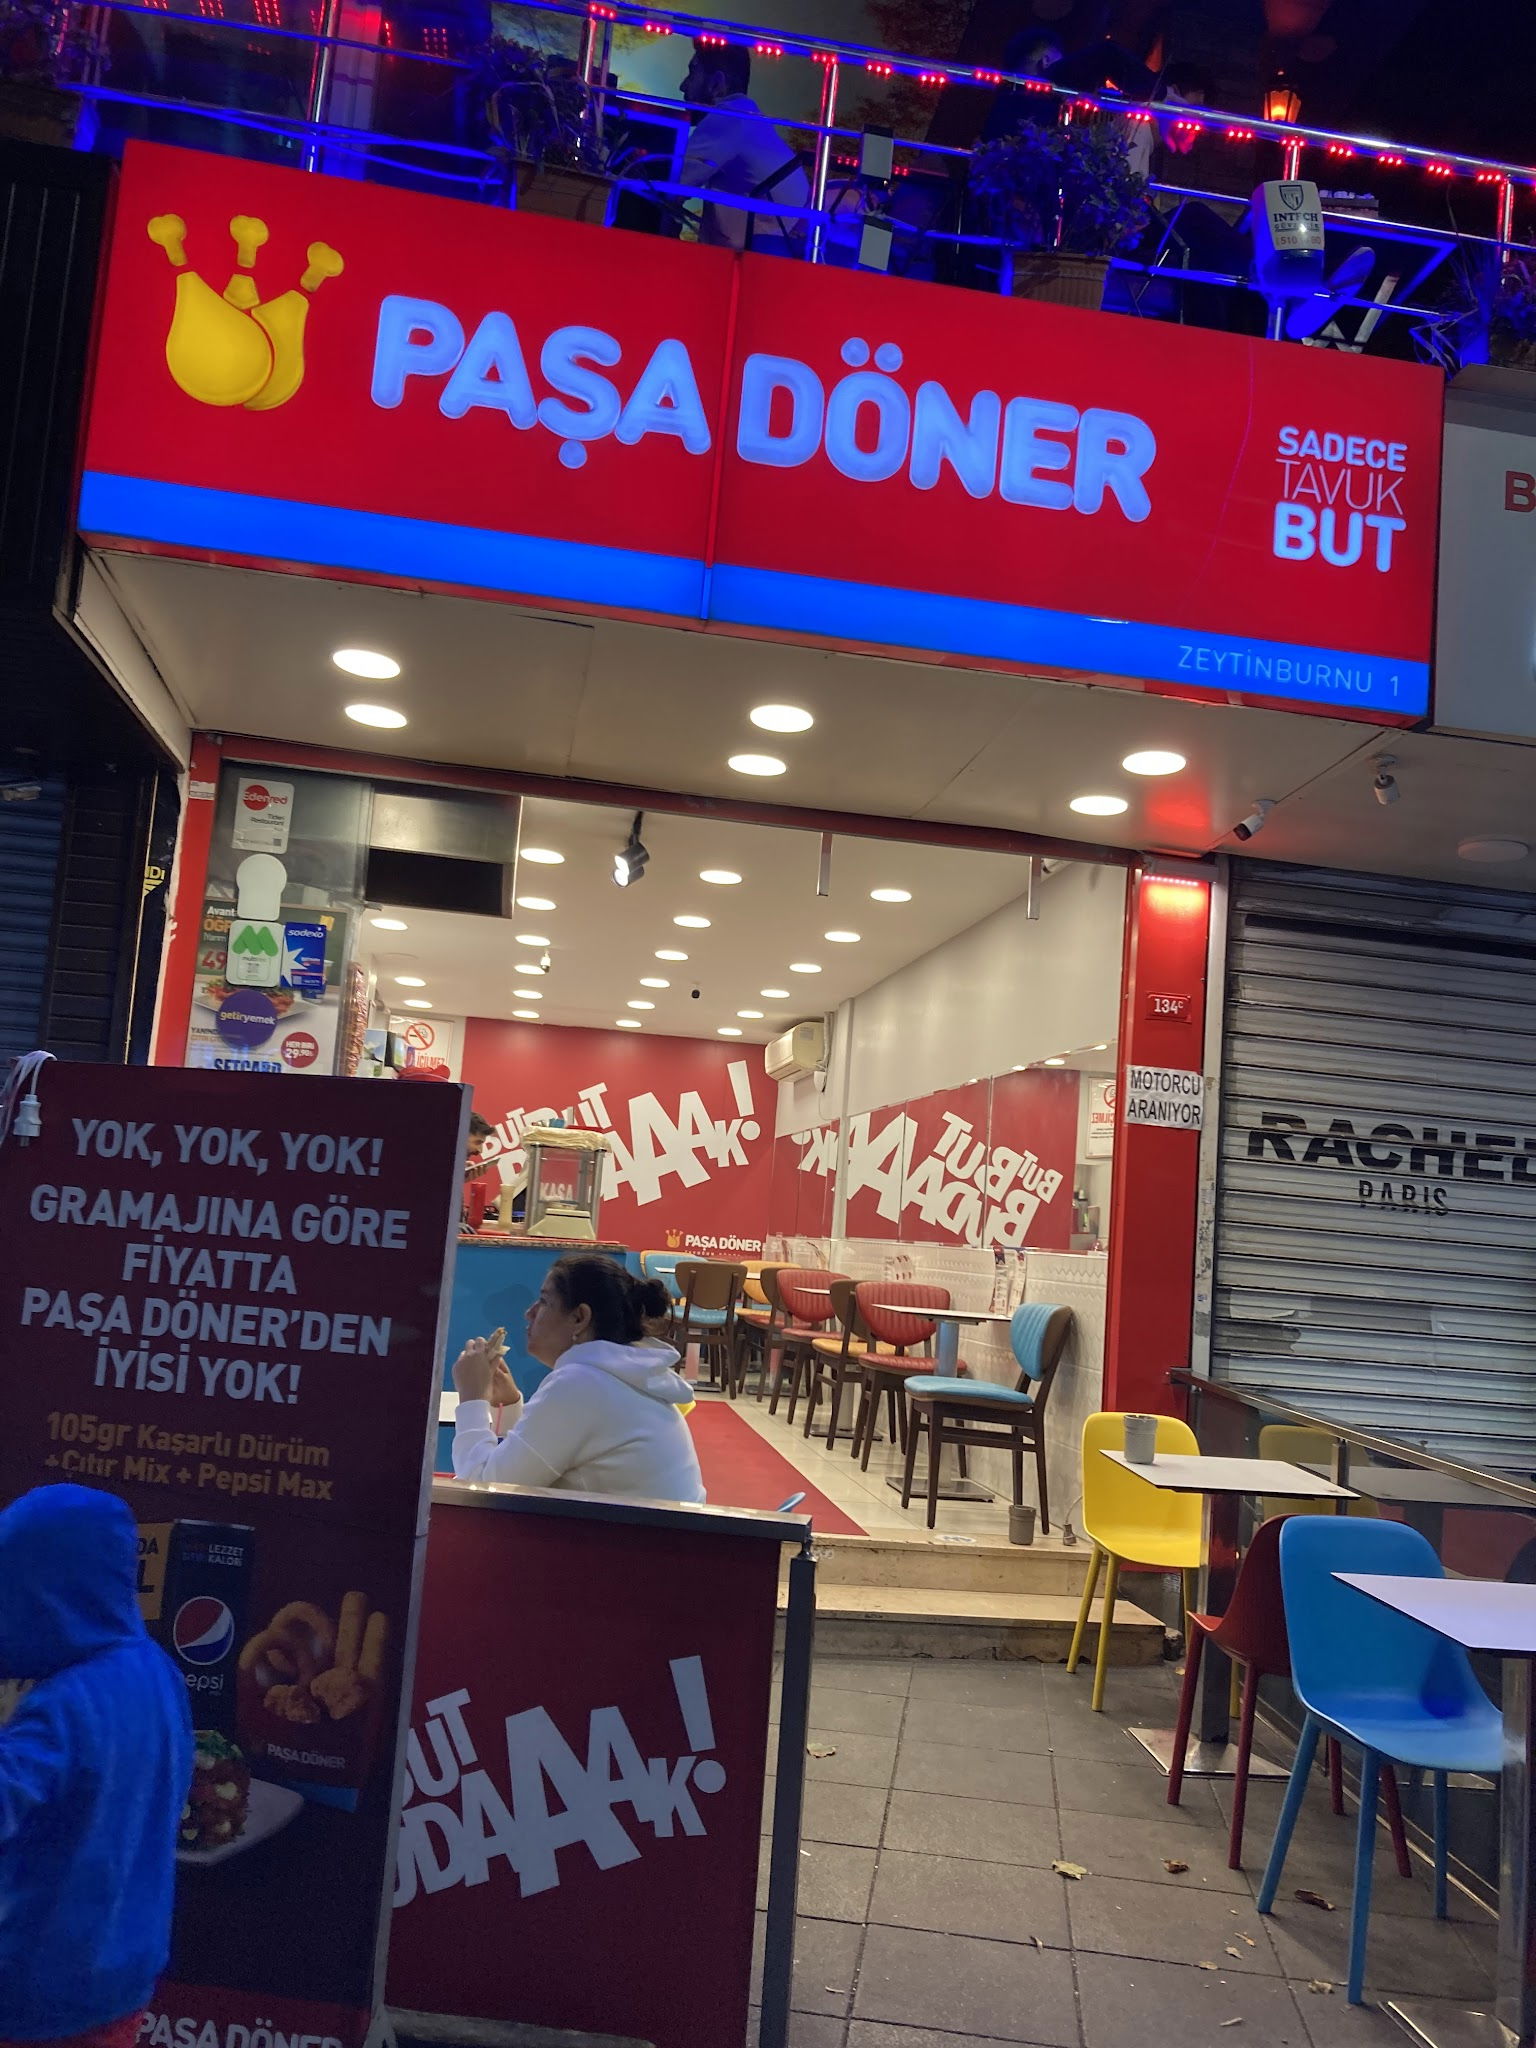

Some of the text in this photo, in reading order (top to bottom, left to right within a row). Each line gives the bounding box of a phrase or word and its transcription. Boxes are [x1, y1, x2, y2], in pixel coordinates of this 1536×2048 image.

[371, 294, 1158, 524] PAŞA DÖNER
[1277, 425, 1408, 473] SADECE
[1275, 458, 1404, 516] TAVUK
[1272, 500, 1408, 573] BUT
[1178, 644, 1399, 697] ZEYTİNBURNU 1
[243, 790, 288, 805] Edenred
[287, 928, 324, 938] sodexo
[220, 1010, 276, 1025] getiryemek
[1130, 1069, 1201, 1096] MOTORCU
[1126, 1098, 1201, 1125] ARANIYOR
[72, 1118, 384, 1177] YOK, YOK, YOK!
[29, 1183, 411, 1250] GRAMAJINA GÖRE
[1358, 1179, 1449, 1217] PARIS
[122, 1234, 297, 1296] FİYATTA
[685, 1234, 762, 1253] PAŞA DÖNER
[20, 1287, 132, 1337] PAŞA
[94, 1336, 302, 1405] İYİSİ YOK!
[47, 1411, 330, 1467] 105gr Kaşarlı Dürüm
[123, 1455, 170, 1485] Mix
[198, 1462, 272, 1497] Pepsi
[277, 1470, 334, 1500] Max
[208, 1544, 244, 1556] LEZZET
